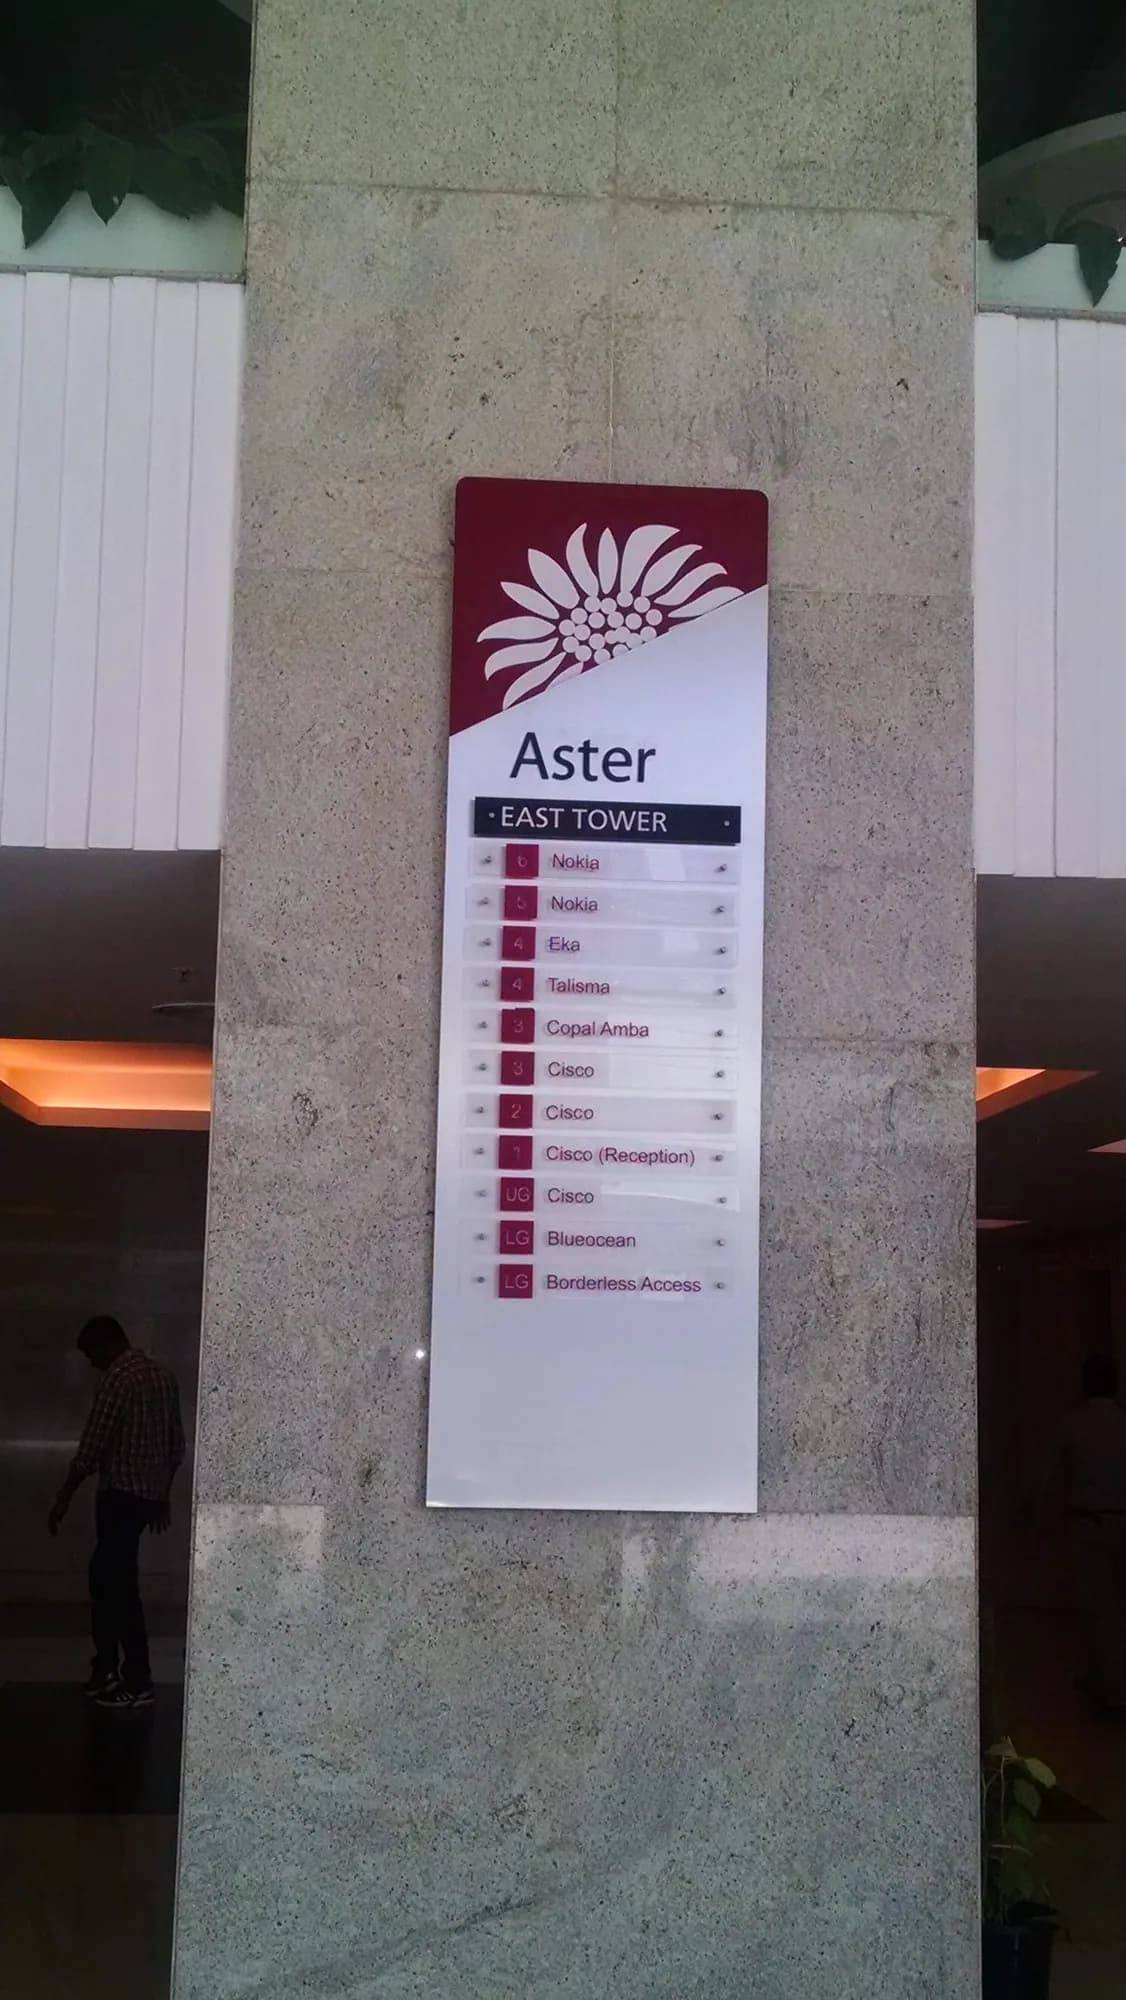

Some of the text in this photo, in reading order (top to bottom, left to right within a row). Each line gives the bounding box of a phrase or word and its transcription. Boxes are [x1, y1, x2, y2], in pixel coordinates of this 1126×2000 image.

[510, 732, 656, 783] Aster
[501, 806, 667, 832] EAST TOWER
[552, 854, 599, 871] Nokia
[551, 895, 598, 912] Nokia
[514, 937, 580, 952] 4 Eka
[513, 977, 610, 993] 4 Talisma
[514, 1020, 649, 1037] 3 Copal Amba
[513, 1062, 594, 1078] 3 Cisco
[511, 1104, 594, 1120] 2 Cisco
[546, 1146, 592, 1161] Cisco
[599, 1148, 696, 1167] (Reception)
[506, 1188, 594, 1203] UG Cisco
[506, 1231, 636, 1248] LG Blueocean
[505, 1275, 702, 1293] LG Borderless Access
